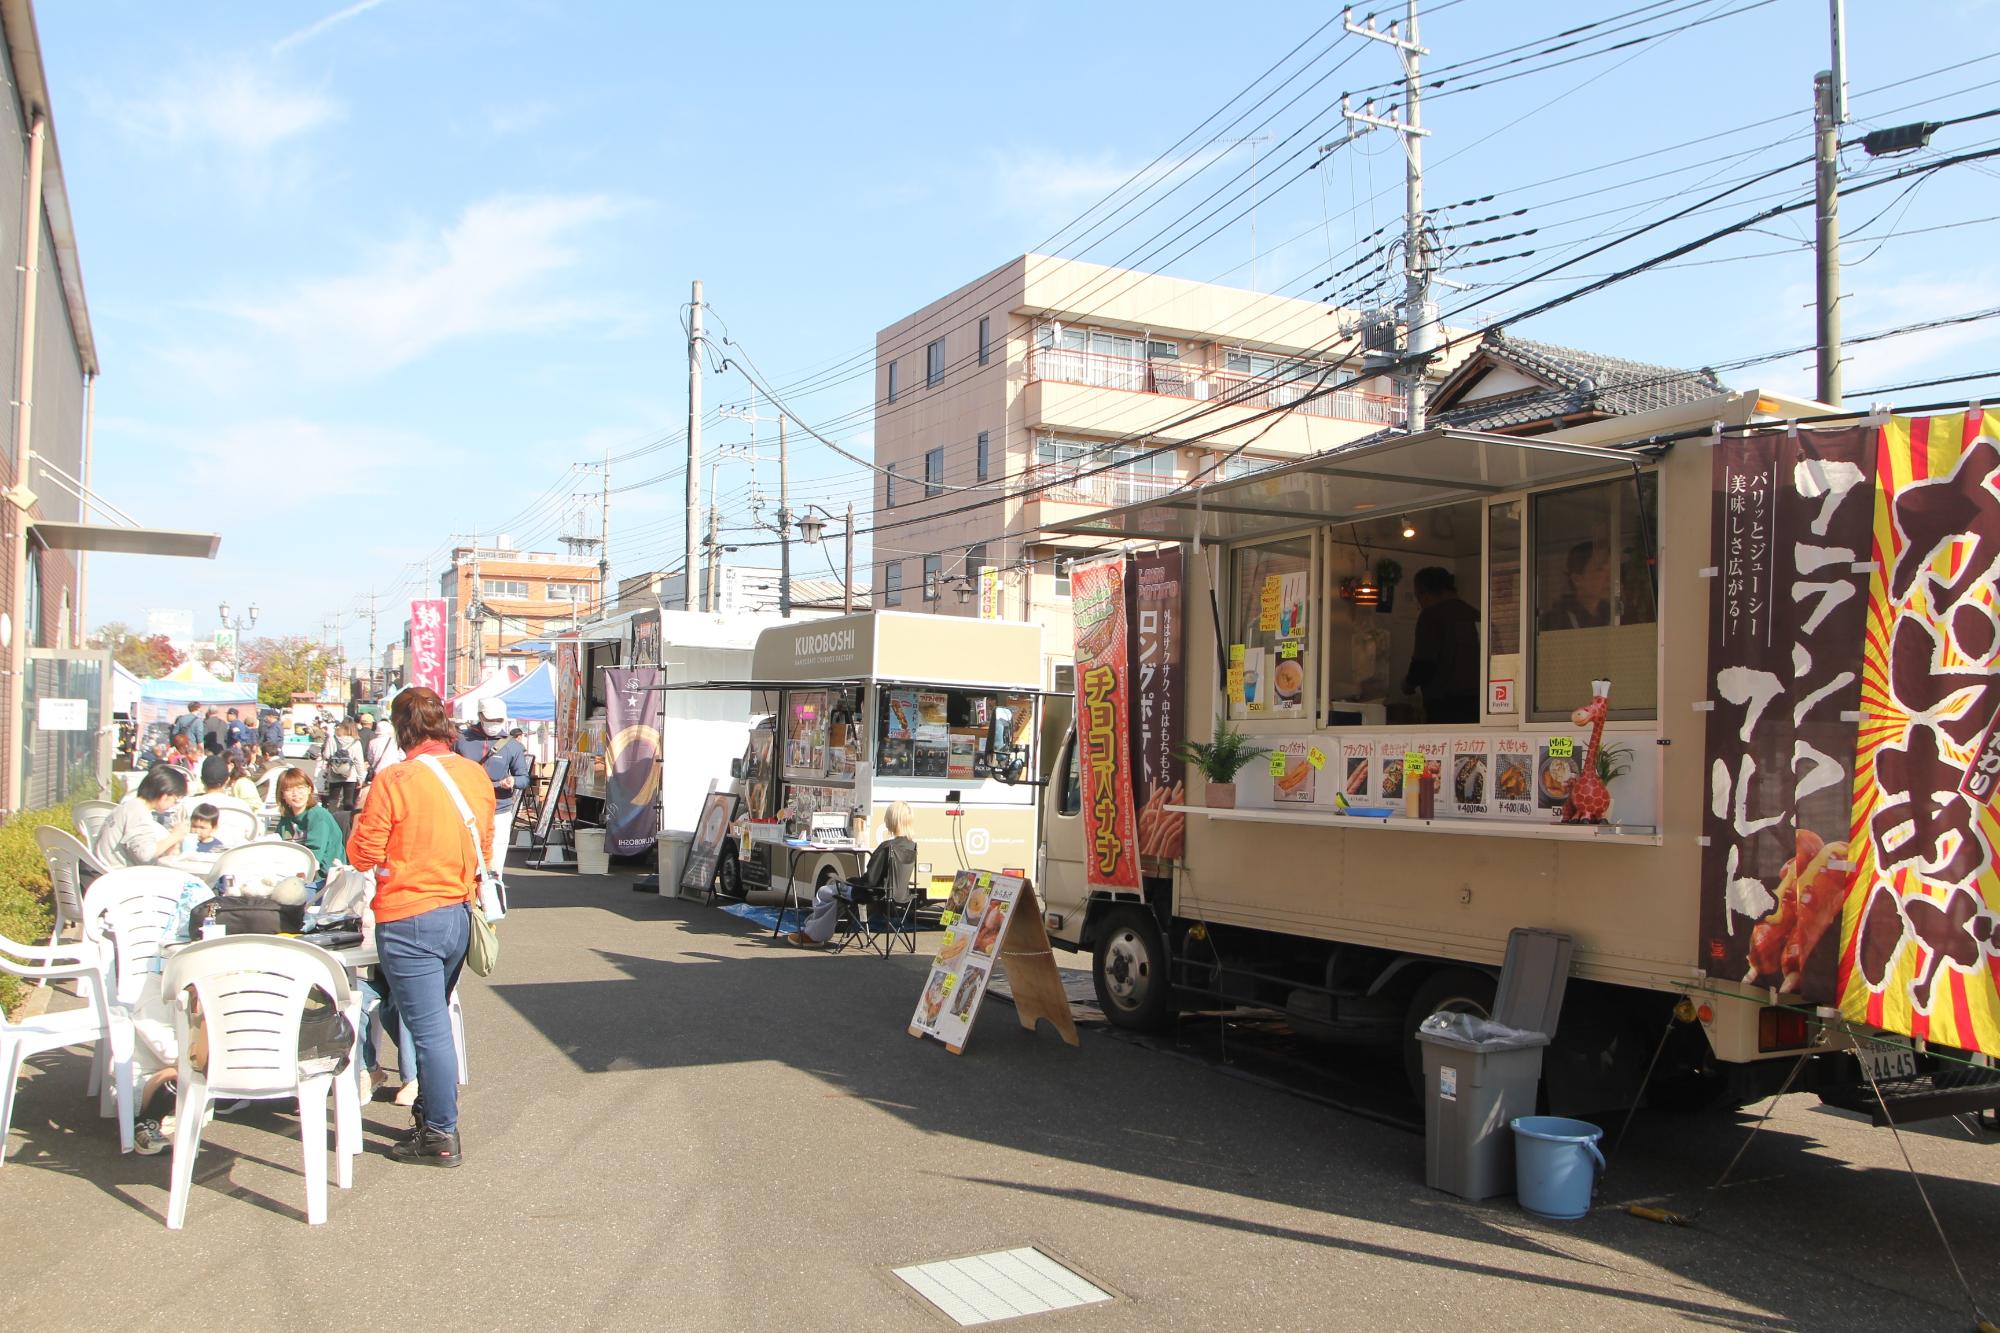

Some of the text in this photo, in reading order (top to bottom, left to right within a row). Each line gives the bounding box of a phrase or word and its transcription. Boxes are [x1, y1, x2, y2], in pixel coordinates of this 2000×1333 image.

[1728, 474, 1746, 636] 美味しさ広がる！
[1750, 471, 1768, 636] パリッとジューシー
[795, 628, 855, 656] KUROBOSHI
[1139, 610, 1158, 783] ロングポテト
[1084, 665, 1121, 875] チョコバナナ
[1711, 666, 1786, 937] フルト
